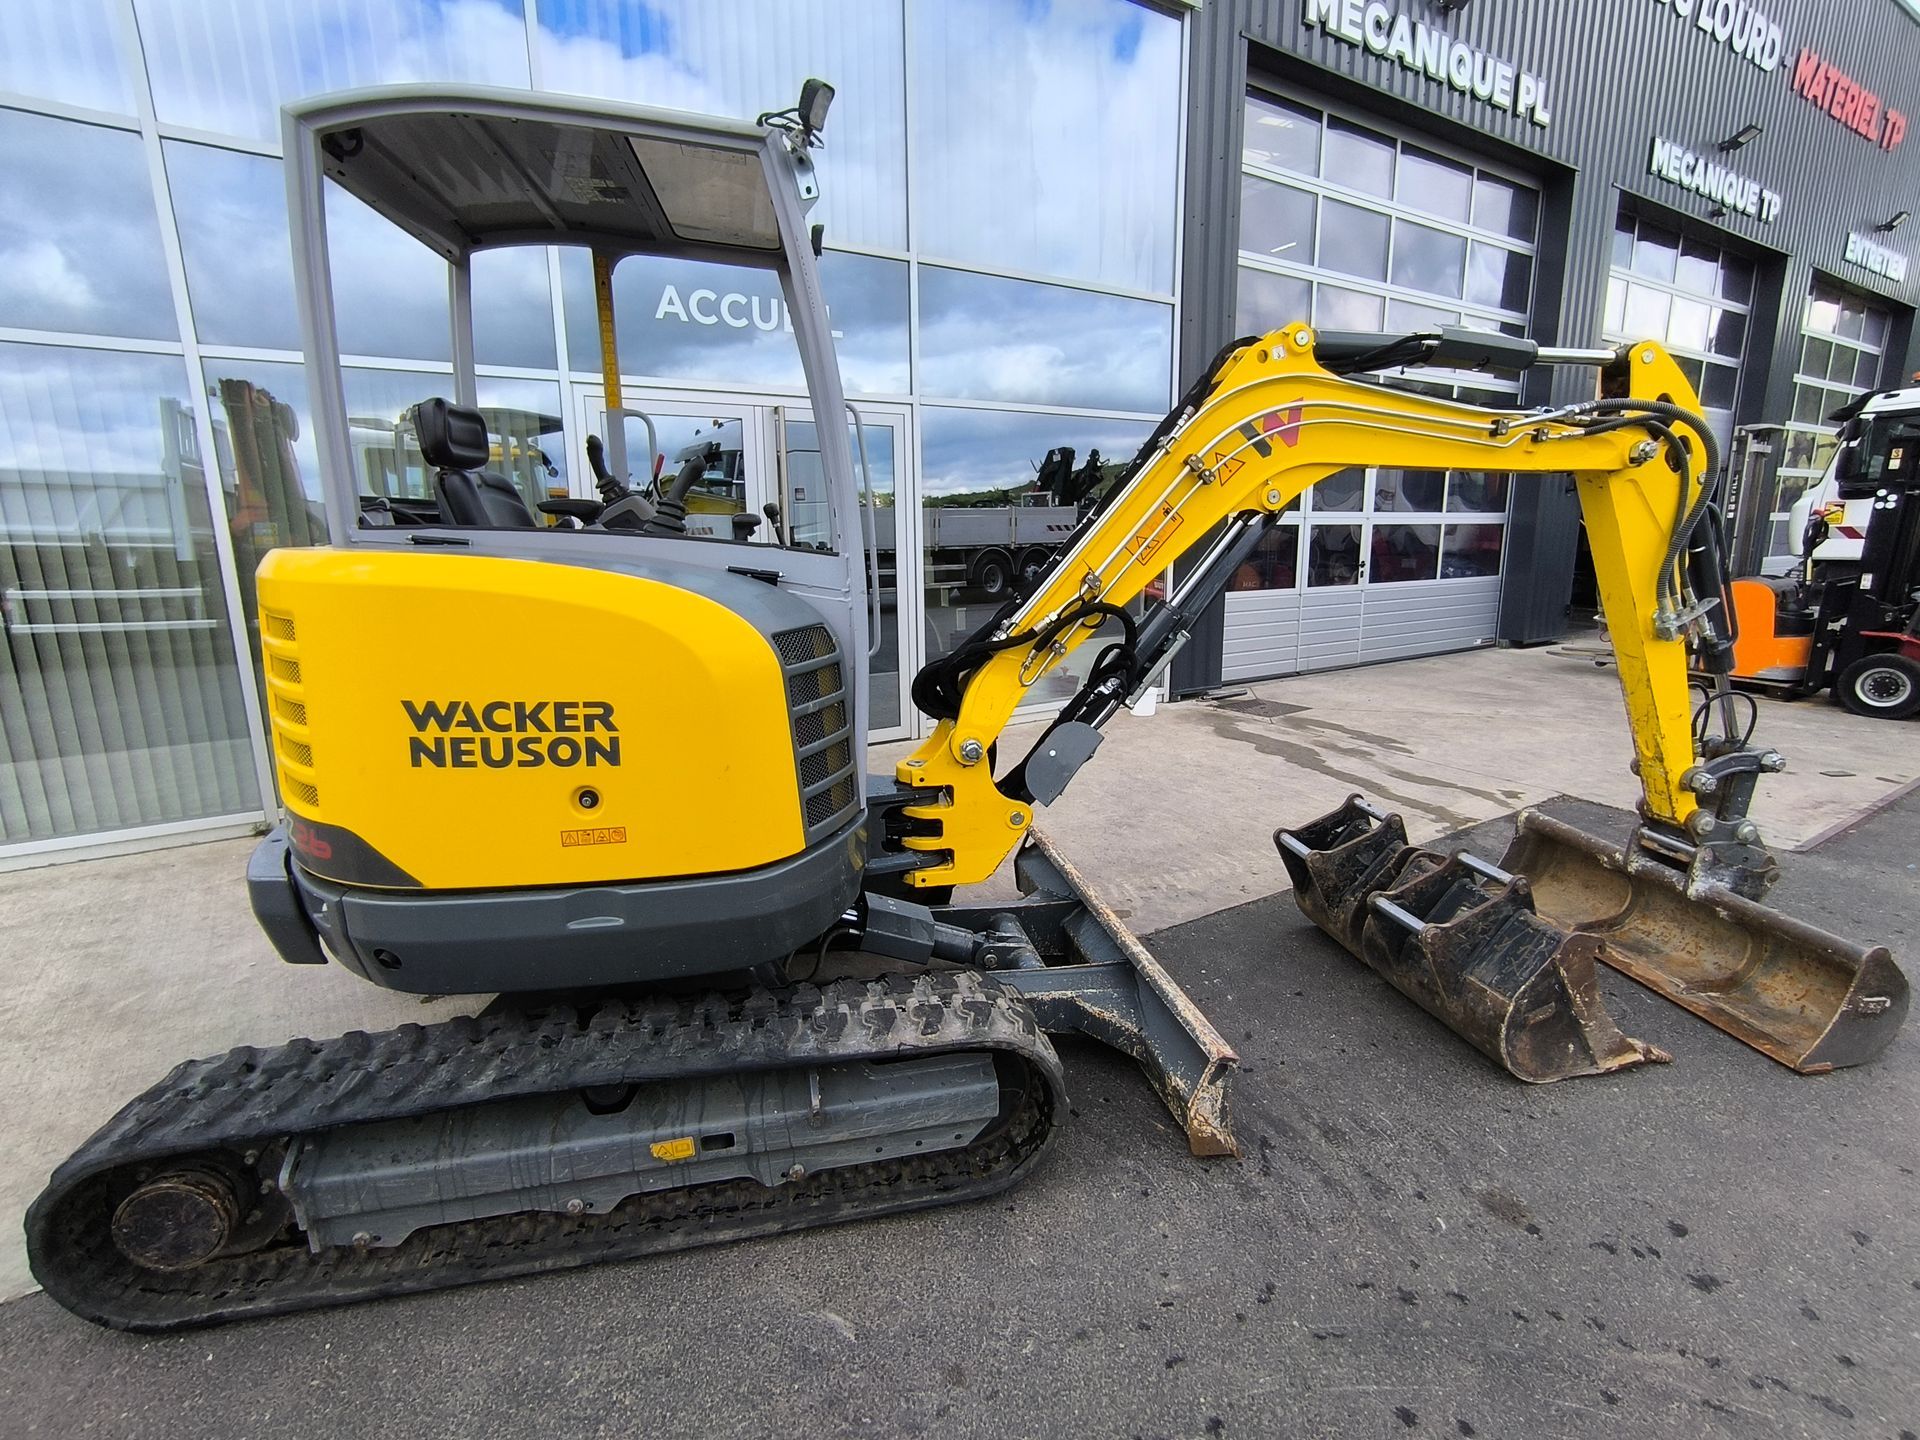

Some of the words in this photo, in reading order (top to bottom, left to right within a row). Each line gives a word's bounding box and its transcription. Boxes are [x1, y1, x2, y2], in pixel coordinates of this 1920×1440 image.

[1305, 0, 1513, 109] MECANIQUE
[1516, 73, 1550, 127] PL
[1696, 0, 1782, 72] LOURD
[1792, 47, 1885, 142] MATERIEL
[1881, 108, 1907, 151] TP
[1648, 136, 1762, 217] MECANIQUE
[1760, 189, 1781, 222] TP
[1844, 232, 1909, 282] ENTRETIEN
[655, 284, 844, 338] ACCU
[401, 700, 619, 733] WACKER
[409, 736, 621, 768] NEUSON
